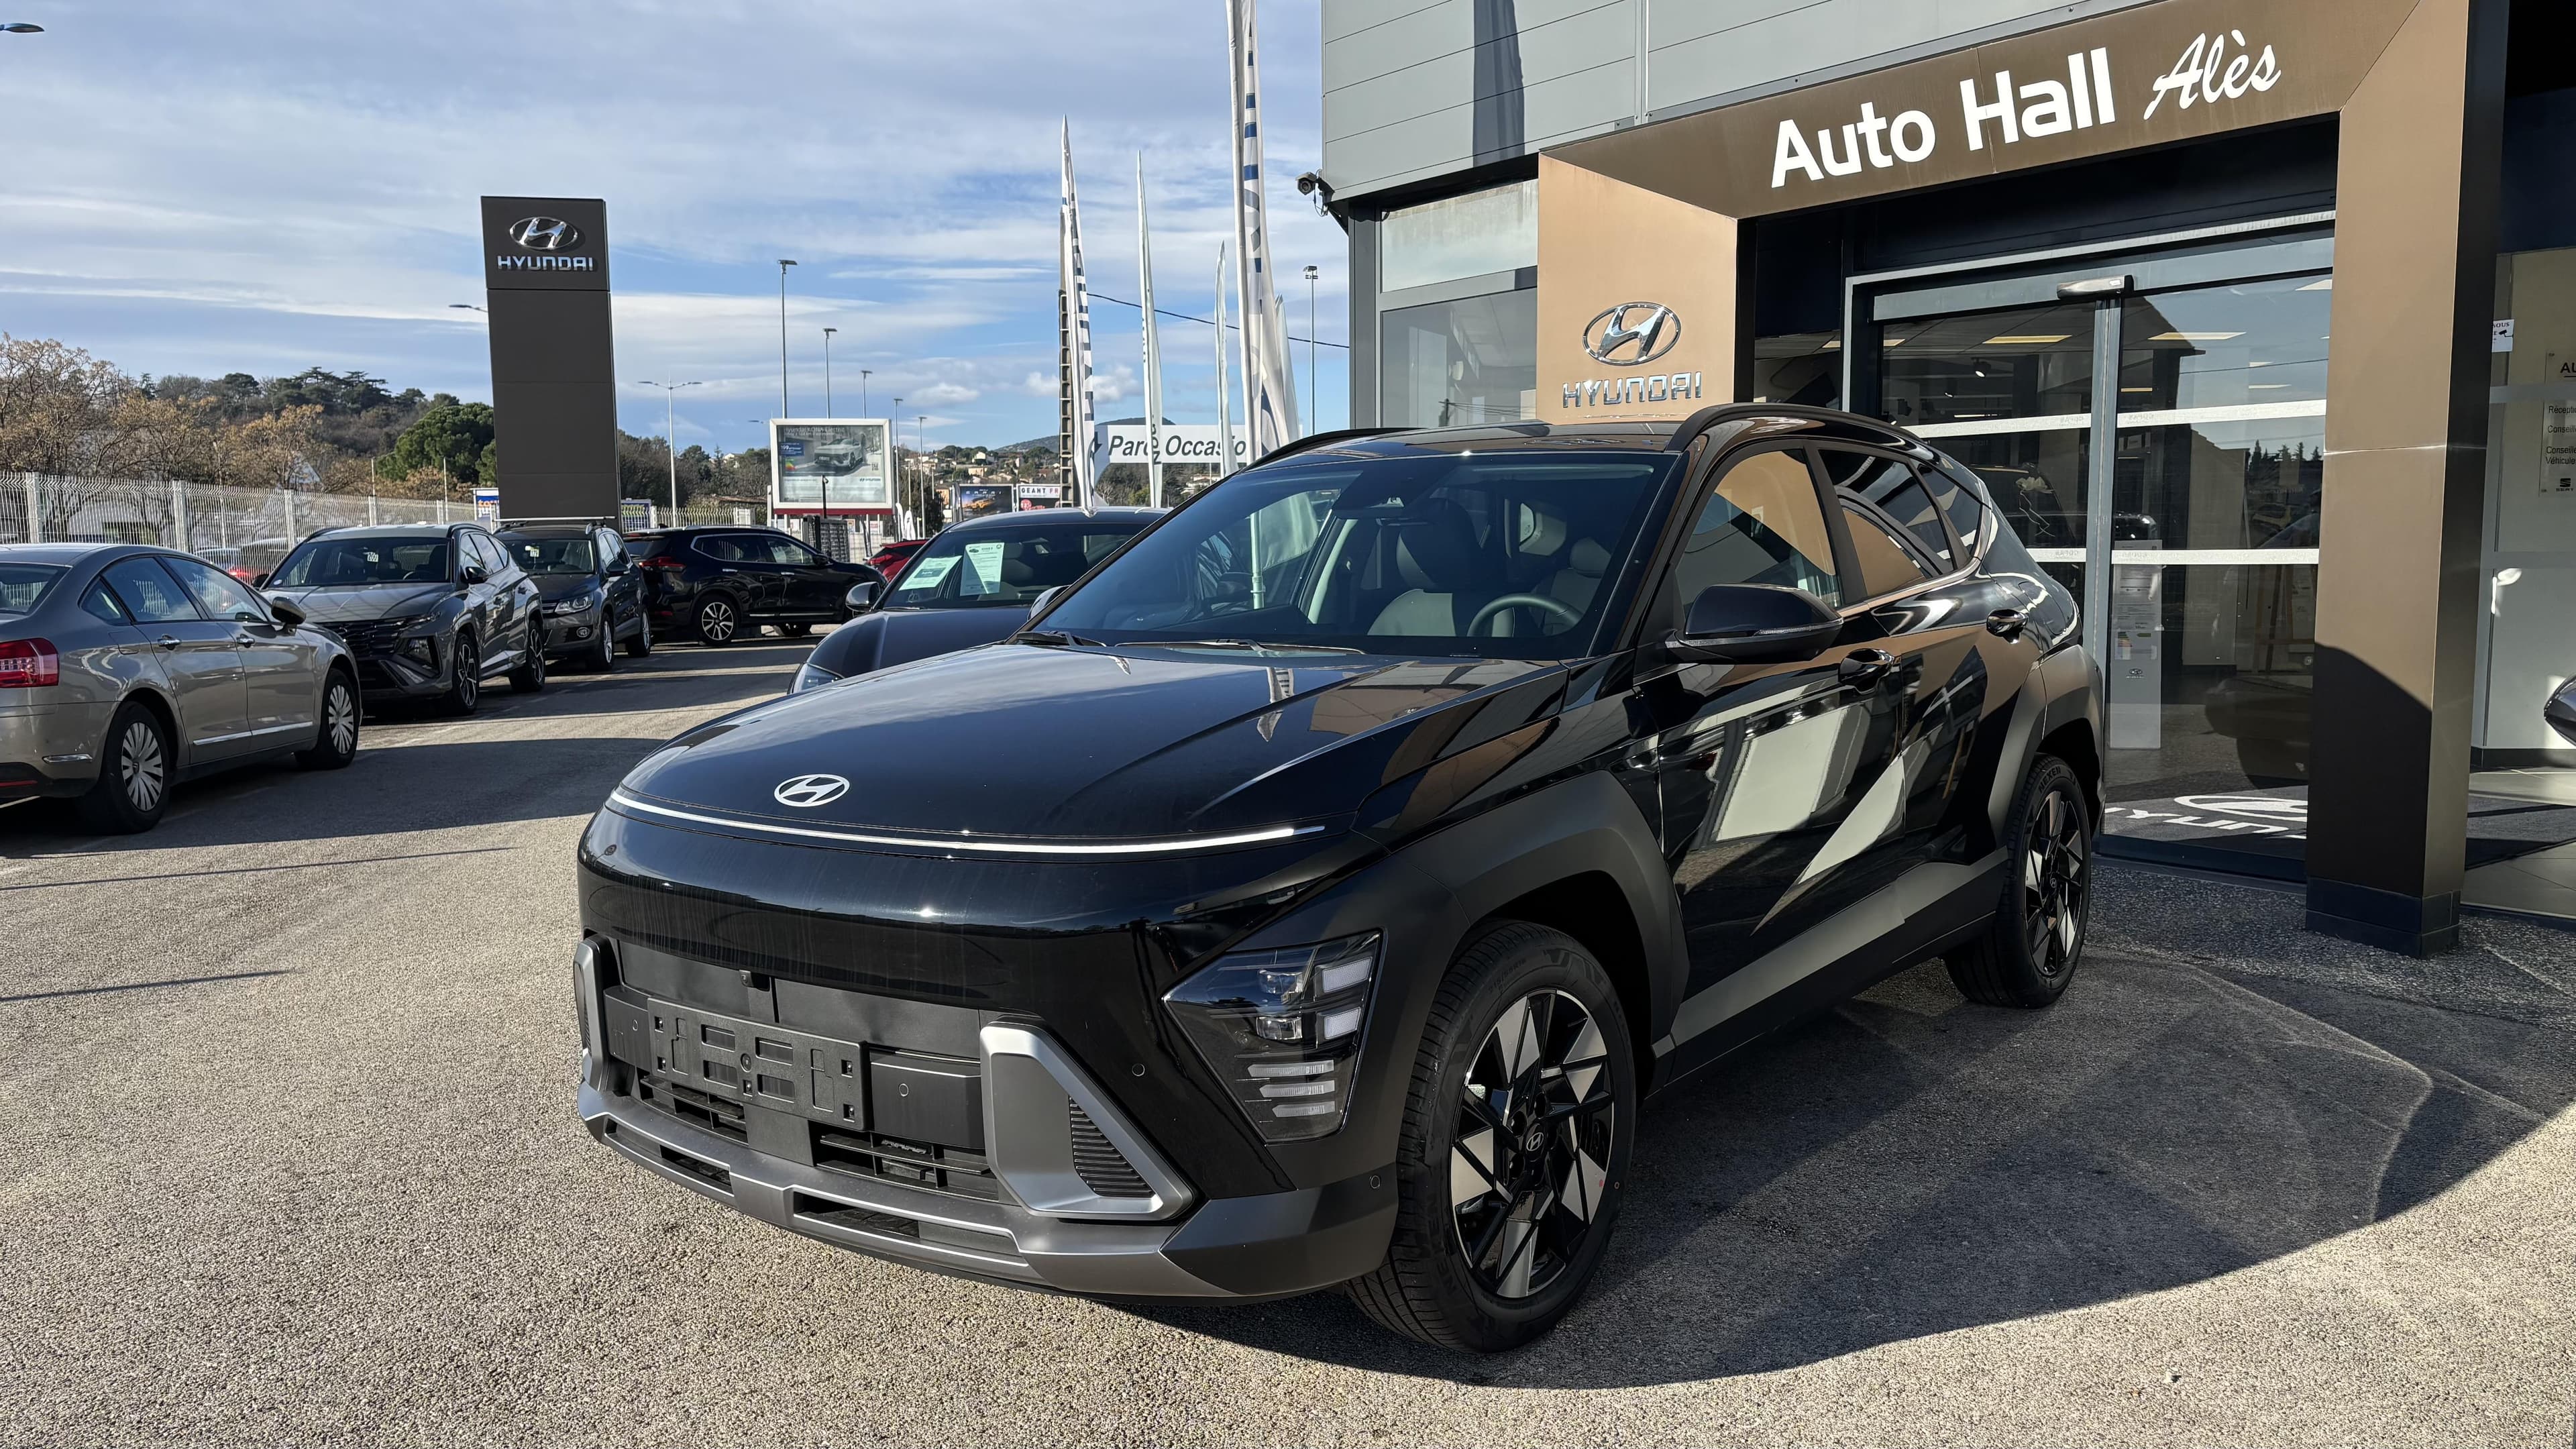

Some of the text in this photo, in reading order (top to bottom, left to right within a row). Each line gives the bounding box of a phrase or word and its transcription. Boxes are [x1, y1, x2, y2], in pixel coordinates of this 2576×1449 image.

[1771, 29, 2282, 189] Auto Hall Alès
[497, 256, 593, 271] HYUNDAI
[1562, 371, 1701, 408] HYUNDAI
[1165, 435, 1246, 456] Occaso
